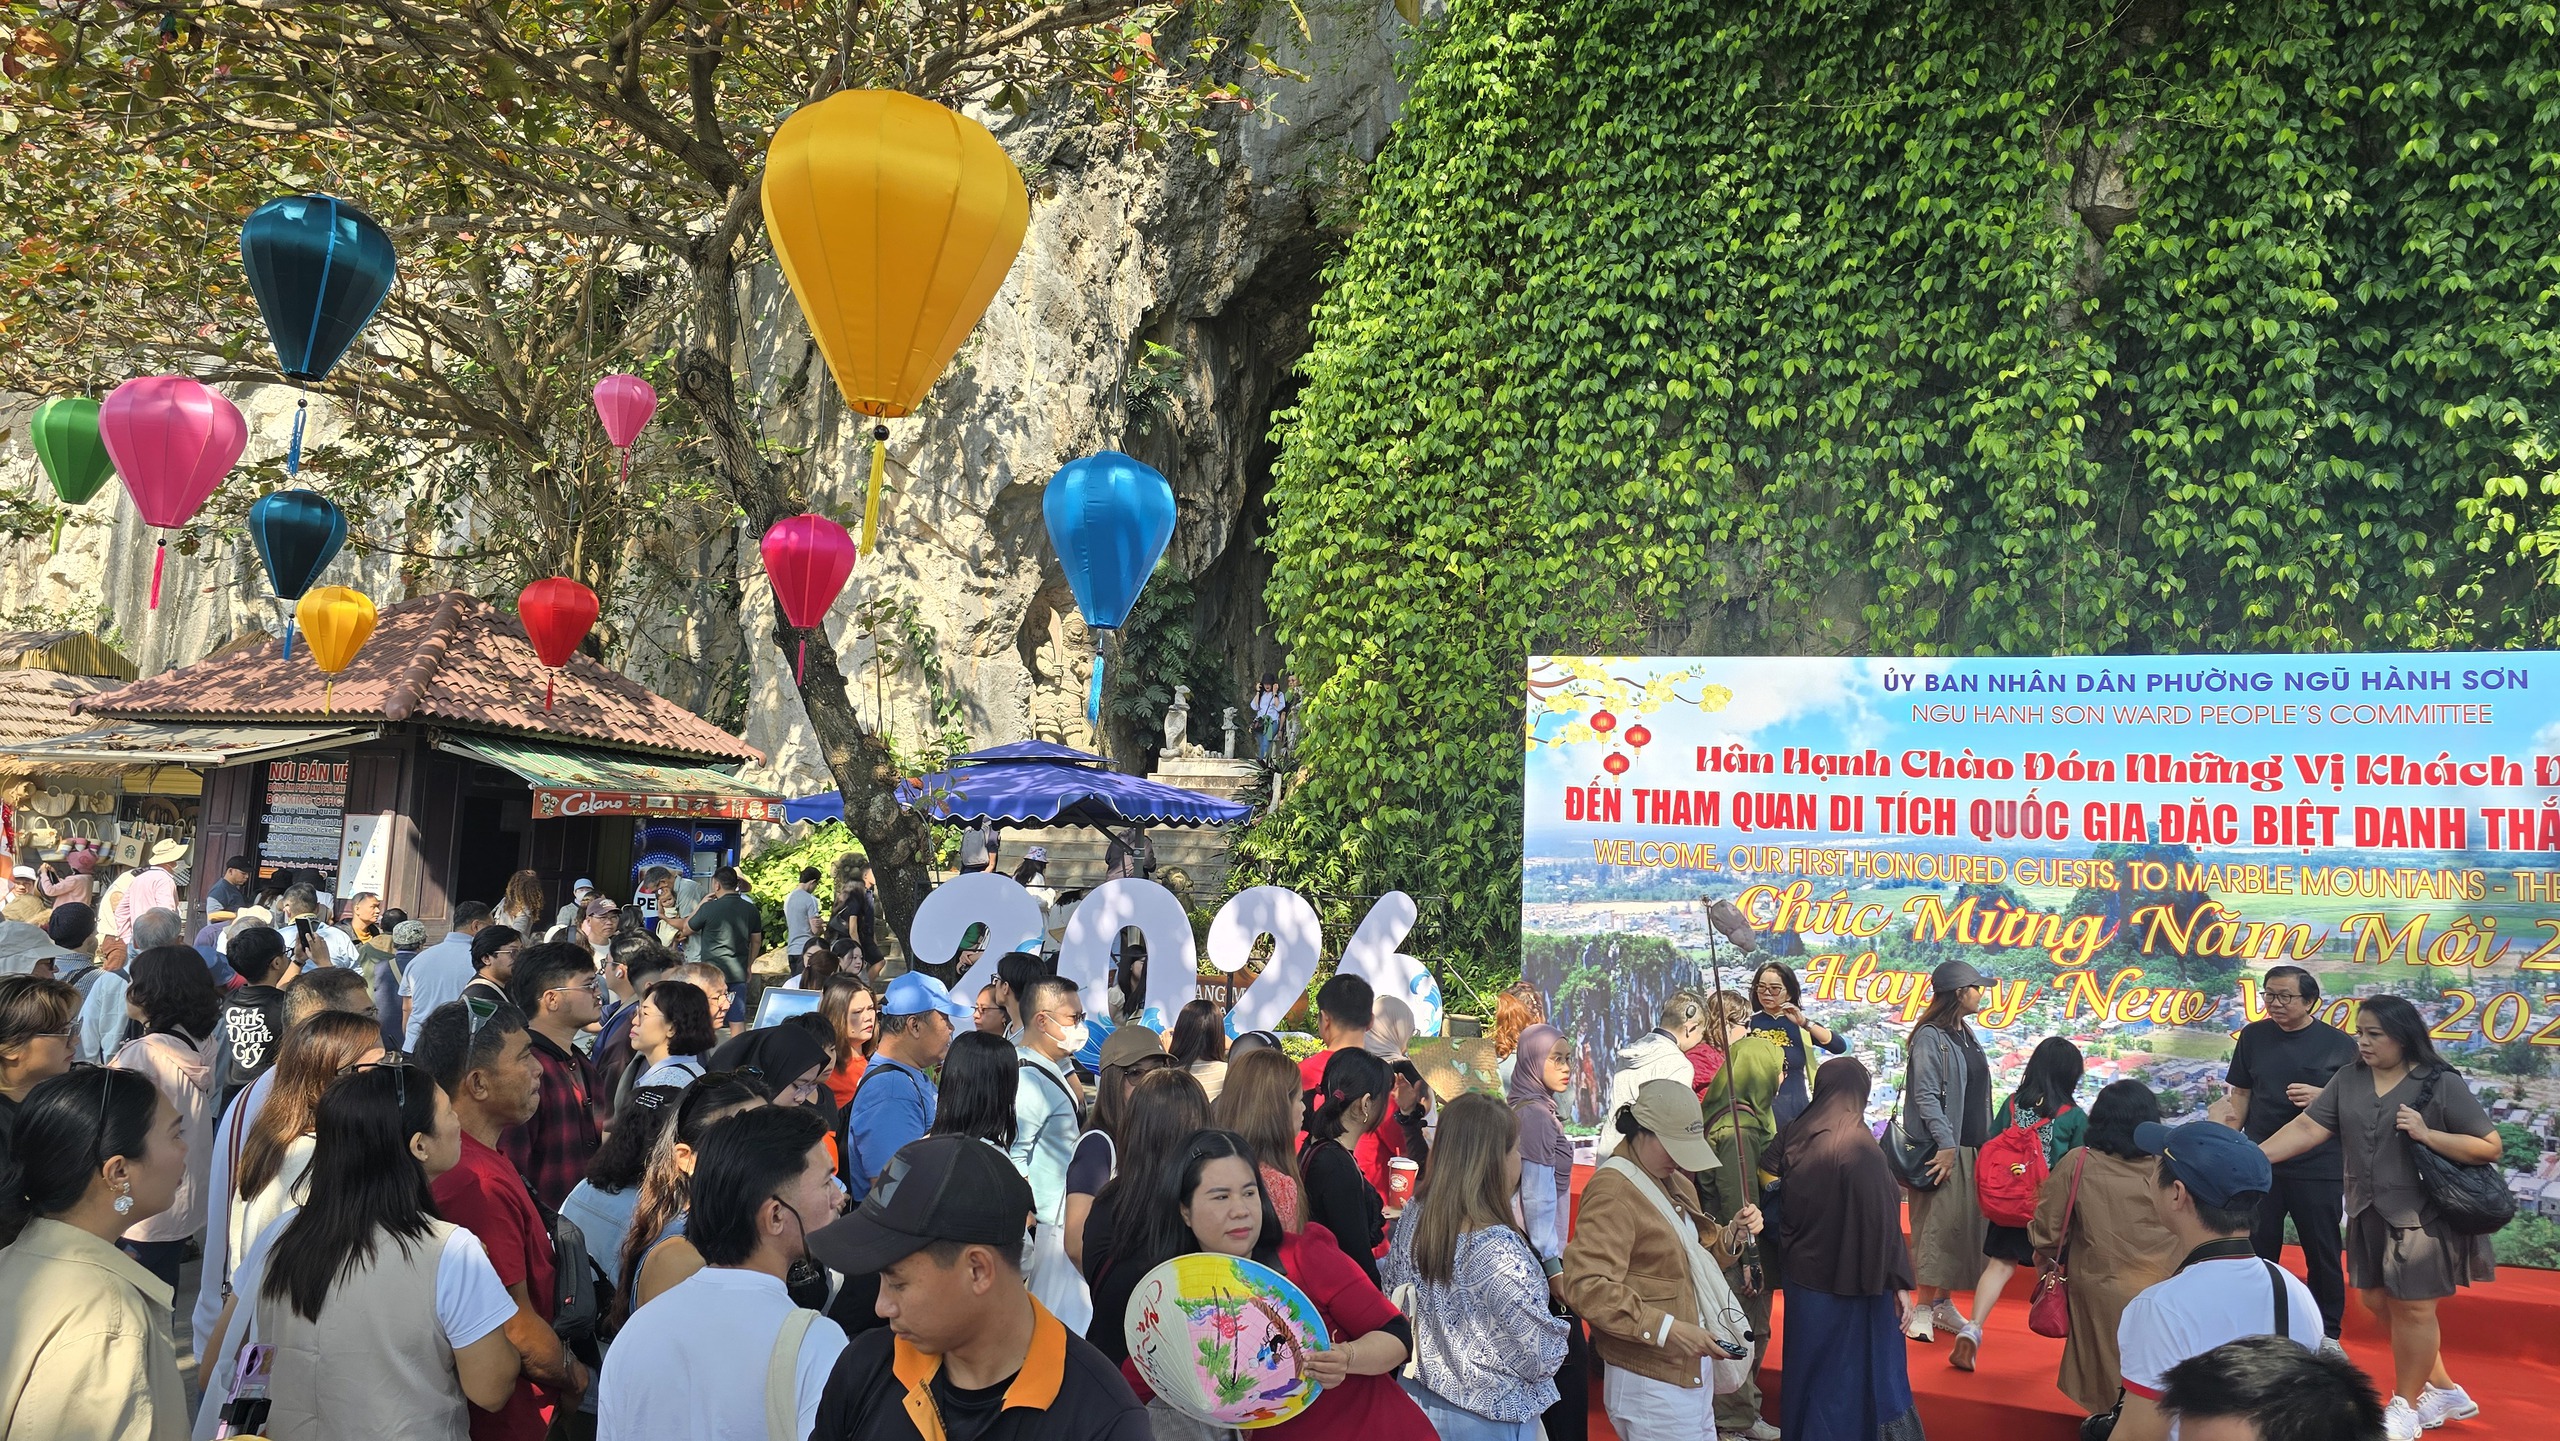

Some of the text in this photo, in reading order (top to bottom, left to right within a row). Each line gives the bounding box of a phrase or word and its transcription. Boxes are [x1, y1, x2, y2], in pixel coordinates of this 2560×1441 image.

[1884, 666, 2528, 693] ỦY BAN NHÂN DÂN PHƯỜNG NGŨ HÀNH SƠN
[1912, 704, 1966, 723] NGU
[1975, 704, 2044, 723] HANH
[2051, 705, 2105, 724] SON
[2110, 705, 2192, 724] WARD
[2330, 704, 2493, 724] COMMITTEE
[268, 761, 296, 781] NƠI
[1696, 743, 1774, 773] Hân
[1783, 747, 1891, 781] Hạnh
[1901, 746, 2014, 780] Chào
[2024, 750, 2115, 782] Đón
[2126, 751, 2284, 792] Những
[2293, 752, 2345, 792] Vị
[2356, 751, 2524, 786] Khách
[266, 794, 345, 808] BOOKING OFFIC
[560, 792, 623, 816] Celano
[1564, 775, 1622, 822] ĐẾN
[1632, 788, 1720, 826] THAM
[1732, 791, 1817, 832] QUAN
[1829, 794, 1863, 833] DI
[1875, 789, 1957, 835] TÍCH
[1969, 787, 2069, 842] QUỐC
[2083, 800, 2150, 843] GIA
[2158, 797, 2238, 852] ĐẶC
[2253, 798, 2341, 854] BIỆT
[2354, 806, 2467, 850] DANH
[704, 832, 723, 844] pepsi
[1594, 838, 1721, 872] WELCOME,
[1729, 844, 1782, 874] OUR
[1788, 847, 1847, 877] FIRST
[1854, 849, 2006, 884] HONOURED
[2013, 857, 2121, 891] GUESTS,
[2127, 861, 2168, 891] TO
[2176, 863, 2293, 897] MARBLE
[2302, 866, 2486, 900] MOUNTAINS
[2512, 871, 2560, 902] THE
[637, 897, 659, 910] PE
[1736, 879, 1896, 938] Chúc
[1902, 894, 2120, 967] Mừng
[2130, 901, 2330, 961] Năm
[2340, 911, 2513, 968] Mới
[910, 872, 1442, 1038] 2026
[1195, 984, 1226, 1003] ANG
[1805, 951, 2044, 1029] Hapy
[2052, 966, 2222, 1026] New
[226, 1007, 265, 1031] Girls
[226, 1025, 273, 1043] Don't
[232, 1042, 266, 1069] Cry
